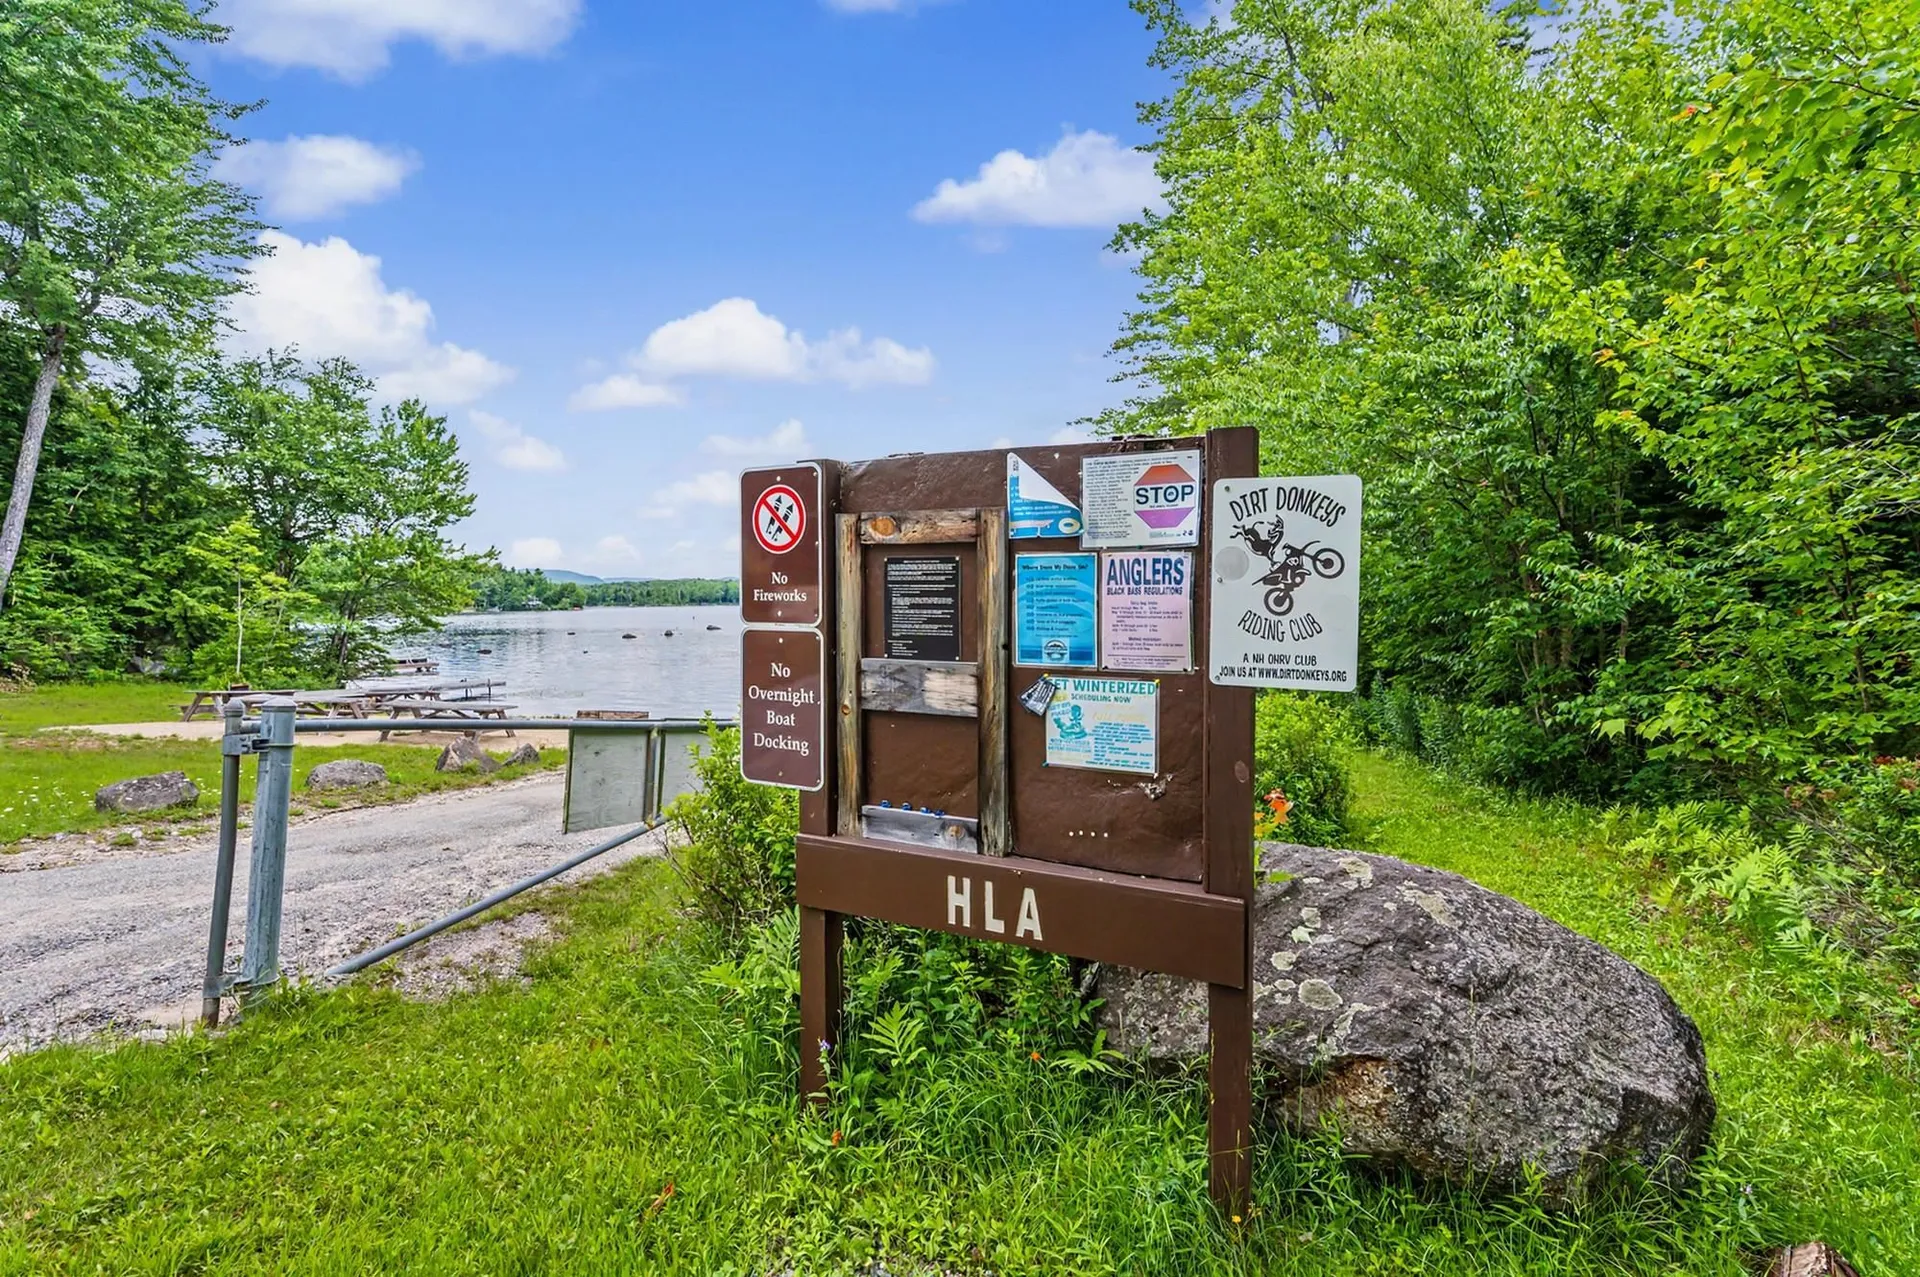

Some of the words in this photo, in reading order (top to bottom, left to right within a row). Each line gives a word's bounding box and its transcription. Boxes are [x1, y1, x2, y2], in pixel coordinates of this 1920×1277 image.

[1136, 484, 1194, 505] STOP
[1229, 487, 1269, 522] DIRT
[1276, 486, 1346, 528] DONKEYS
[771, 572, 788, 585] No
[1106, 557, 1184, 586] ANGLERS
[753, 588, 808, 602] Fireworks
[1106, 586, 1125, 596] BLACK
[1127, 586, 1142, 596] BASS
[1144, 586, 1183, 596] REGULATIONS
[1237, 609, 1286, 643] RIDING
[1289, 612, 1323, 642] CLUB
[1243, 652, 1250, 664] A
[1252, 653, 1264, 664] NH
[1294, 655, 1318, 666] CLUB
[770, 662, 791, 678] No
[1220, 666, 1236, 677] JOIN
[1237, 666, 1246, 678] US
[1248, 666, 1257, 678] AT
[1258, 667, 1347, 682] WWW.DIRTDONKEYS.ORG
[1073, 680, 1156, 695] WINTERIZED
[748, 685, 815, 707] Overnight
[1072, 693, 1112, 703] SCHEDULING
[1114, 696, 1132, 704] NOW
[766, 710, 796, 727] Boat
[754, 732, 810, 756] Docking
[947, 874, 1043, 940] HLA
